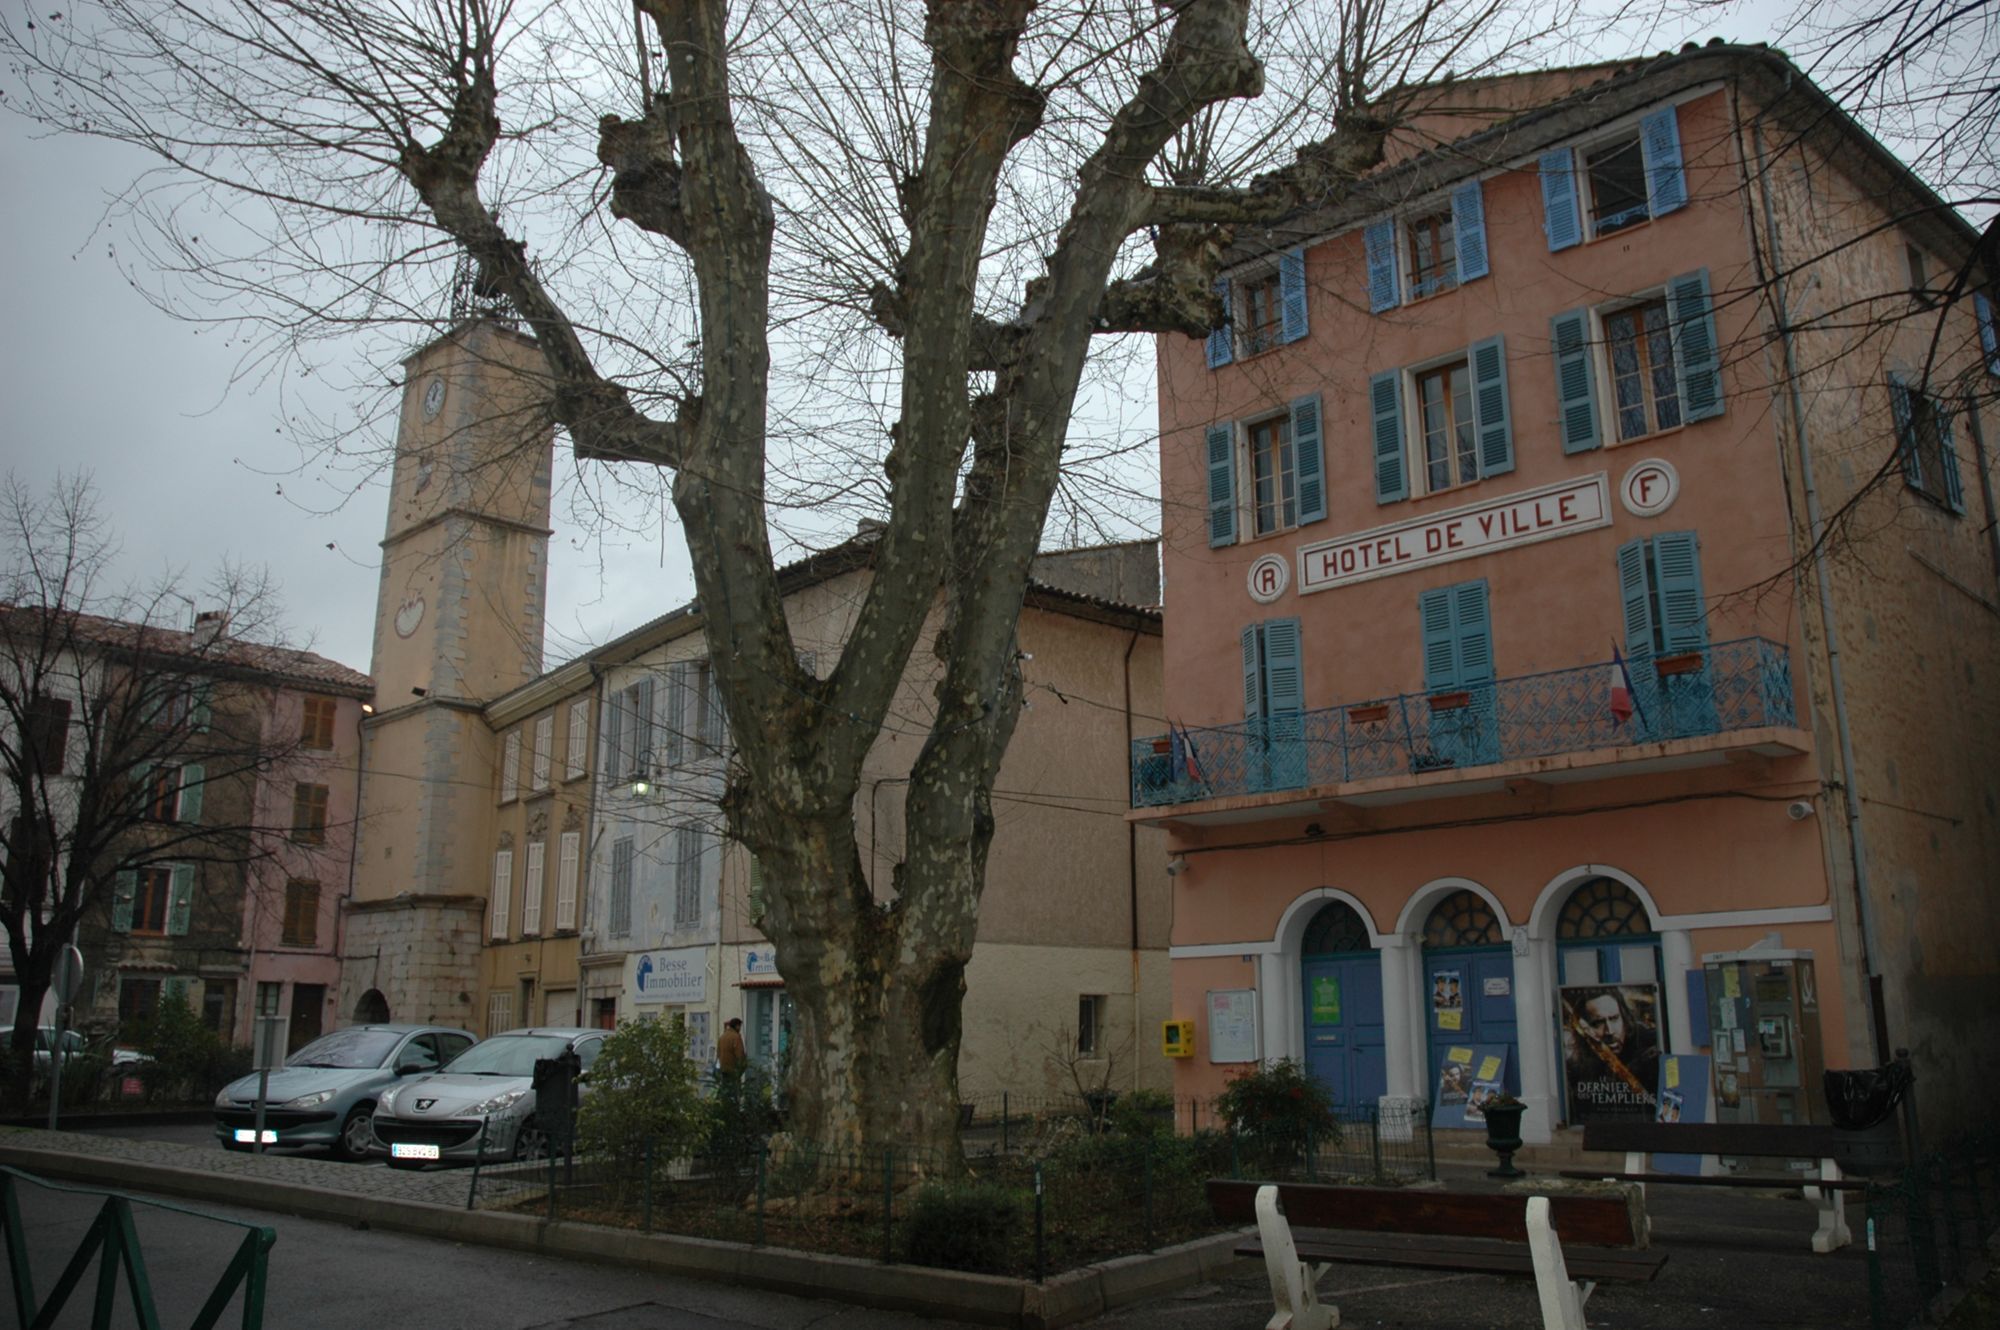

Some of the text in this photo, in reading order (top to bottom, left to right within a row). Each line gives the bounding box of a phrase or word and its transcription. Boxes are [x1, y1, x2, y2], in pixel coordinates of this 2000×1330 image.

[1637, 474, 1658, 503] F
[1323, 494, 1579, 578] HOTEL DE VILLE
[1262, 569, 1276, 592] R
[659, 957, 687, 972] Besse
[645, 972, 703, 990] Immobilier
[1577, 1081, 1630, 1093] DERNIER
[1591, 1093, 1656, 1105] TEMPLIERS
